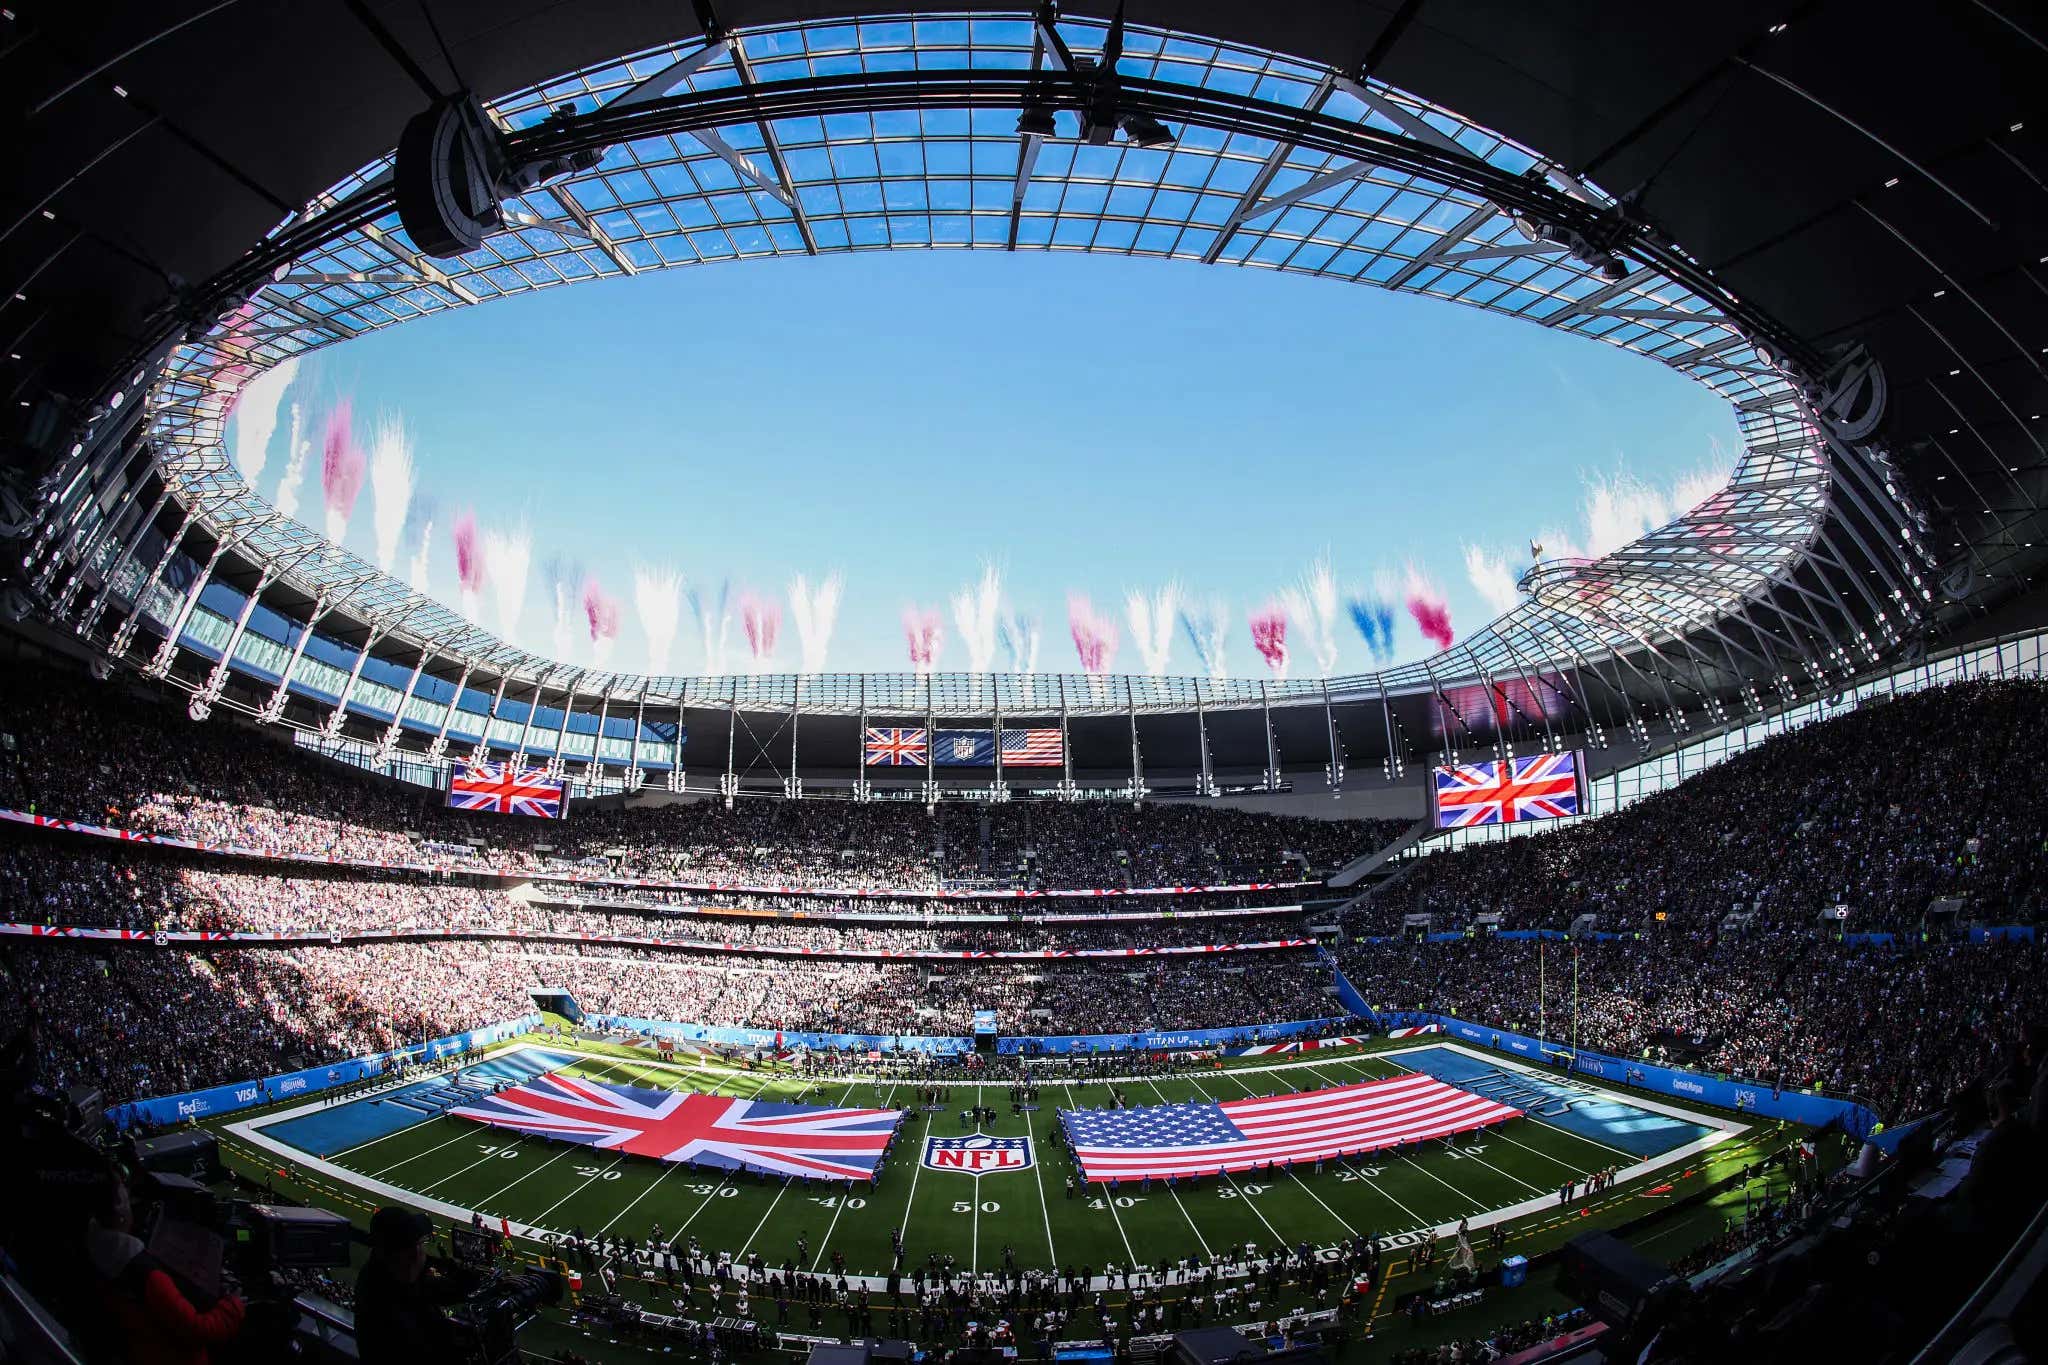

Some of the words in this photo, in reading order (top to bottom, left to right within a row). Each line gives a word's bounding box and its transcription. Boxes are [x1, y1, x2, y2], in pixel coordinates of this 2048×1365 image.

[955, 745, 974, 757] NFL
[1147, 1037, 1175, 1045] TITAN
[1177, 1035, 1190, 1044] UP
[235, 1087, 258, 1103] VISA
[478, 1145, 519, 1159] 10
[934, 1149, 1021, 1169] NFL
[1443, 1145, 1484, 1160] 10
[576, 1166, 622, 1181] 20
[1335, 1167, 1380, 1182] 20
[692, 1184, 739, 1198] 30
[1217, 1184, 1264, 1199] 30
[819, 1196, 866, 1209] 40
[952, 1201, 1001, 1212] 50
[1087, 1197, 1135, 1210] 40
